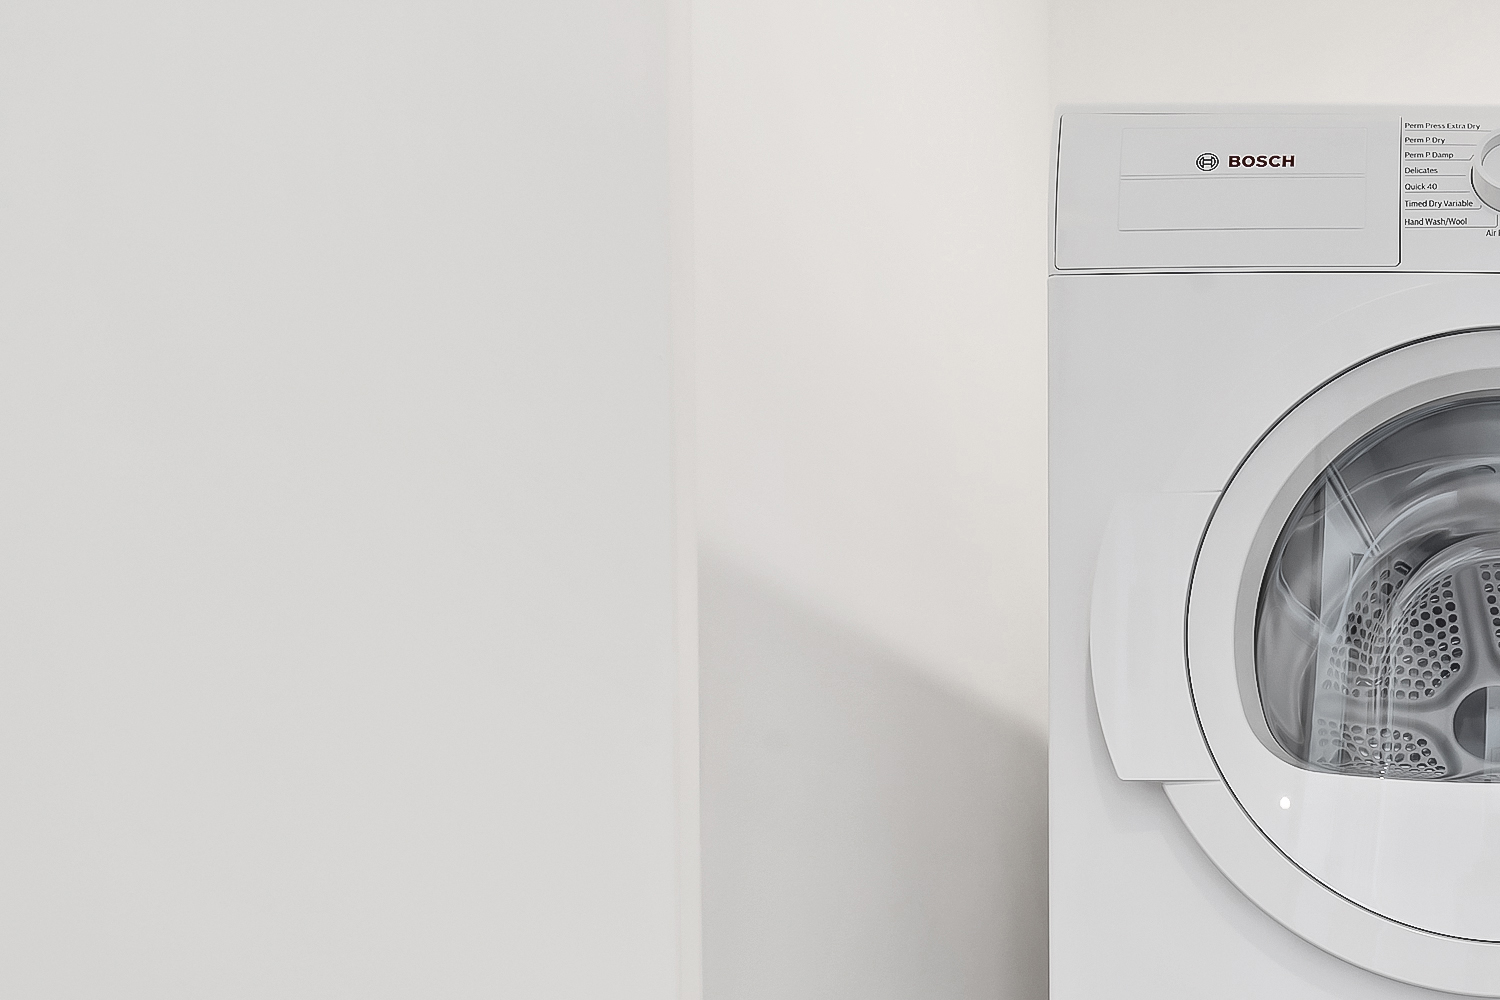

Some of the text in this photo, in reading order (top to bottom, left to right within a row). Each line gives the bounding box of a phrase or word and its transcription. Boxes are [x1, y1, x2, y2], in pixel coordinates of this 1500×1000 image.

[1432, 152, 1454, 160] Damp
[1228, 155, 1295, 168] BOSCH
[1404, 200, 1474, 208] Timed Dry Variable
[1425, 217, 1468, 226] Wash/Wool
[1485, 229, 1497, 237] Air
